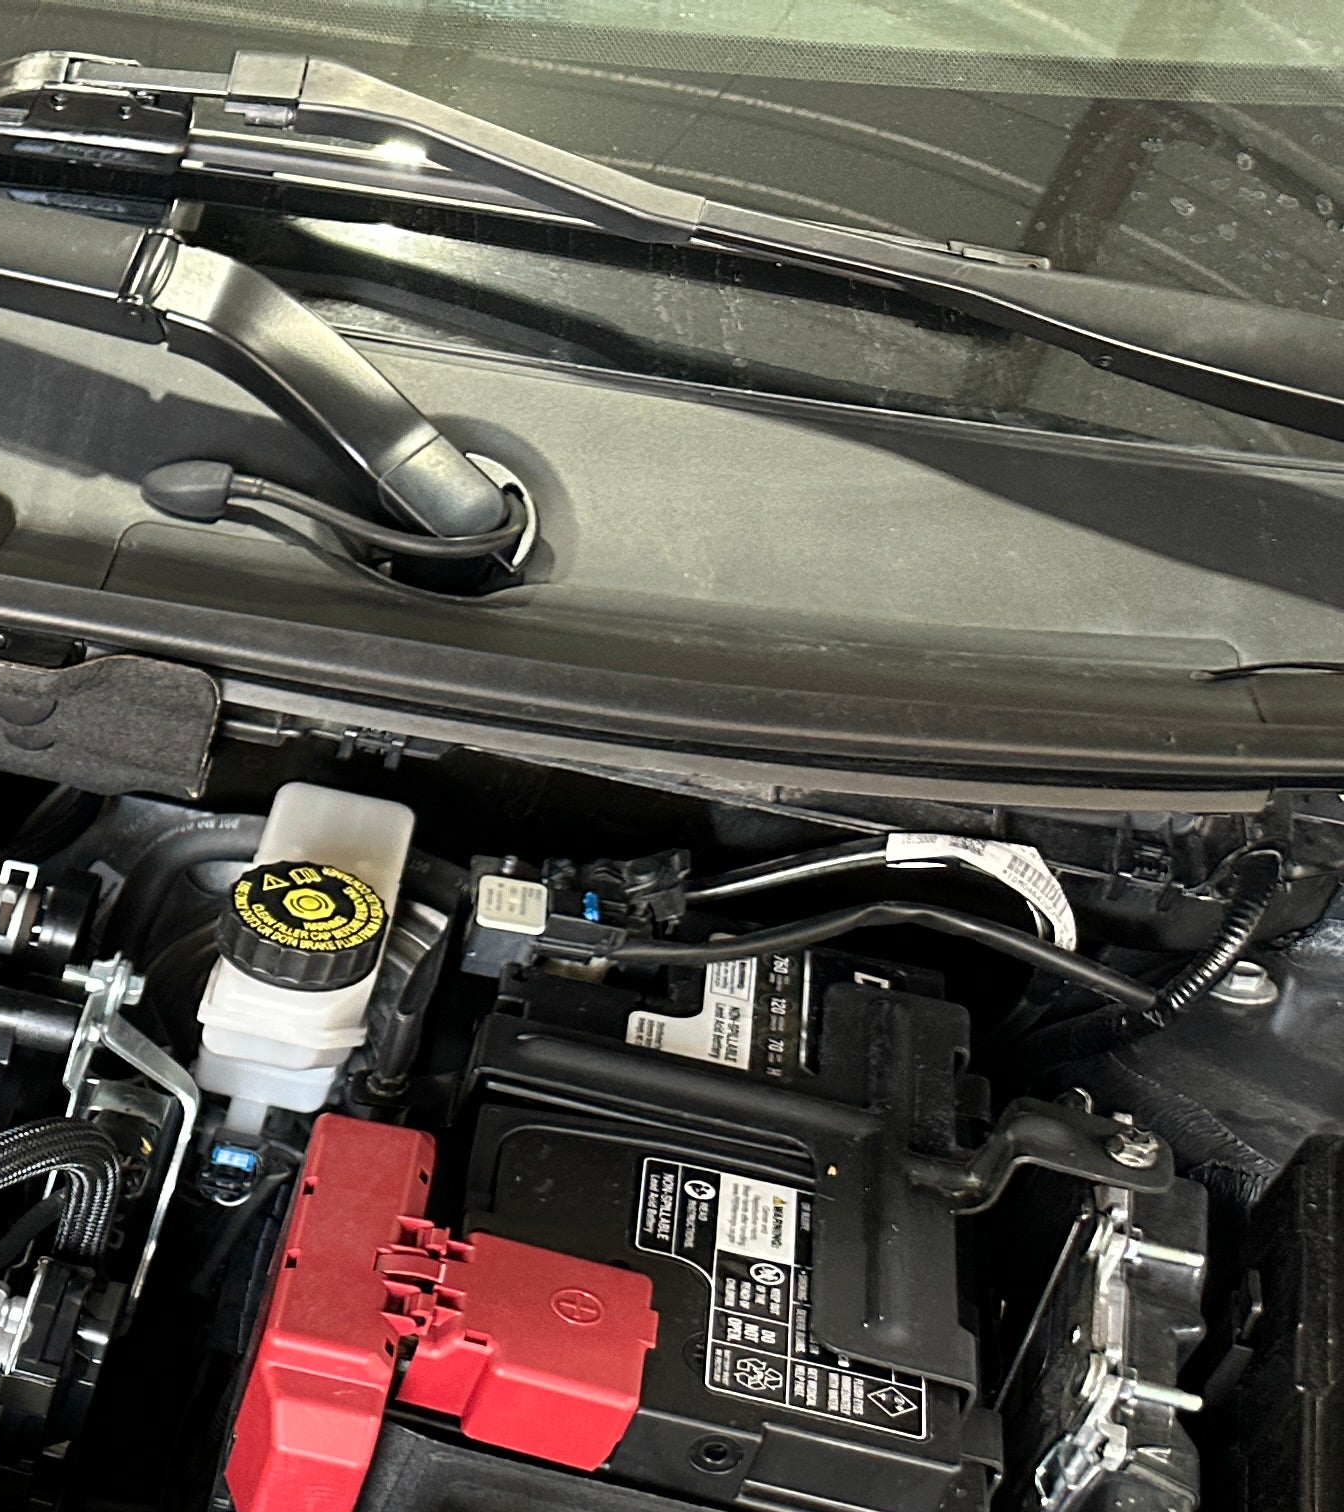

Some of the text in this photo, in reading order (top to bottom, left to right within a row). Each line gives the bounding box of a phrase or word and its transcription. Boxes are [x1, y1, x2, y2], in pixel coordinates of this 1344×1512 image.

[252, 903, 277, 925] CLEAN
[274, 921, 308, 939] FILLER
[310, 931, 331, 940] CAP
[300, 939, 336, 950] BRAKE
[770, 997, 787, 1016] 120
[708, 1033, 724, 1059] Battery
[724, 1006, 741, 1063] NON-SPILLABLE
[767, 1037, 785, 1053] 70
[656, 1172, 675, 1241] NON-SPILLABLE
[642, 1207, 658, 1234] Battery
[727, 1317, 743, 1342] OPEN.
[744, 1323, 759, 1343] NOT
[761, 1329, 776, 1344] DO
